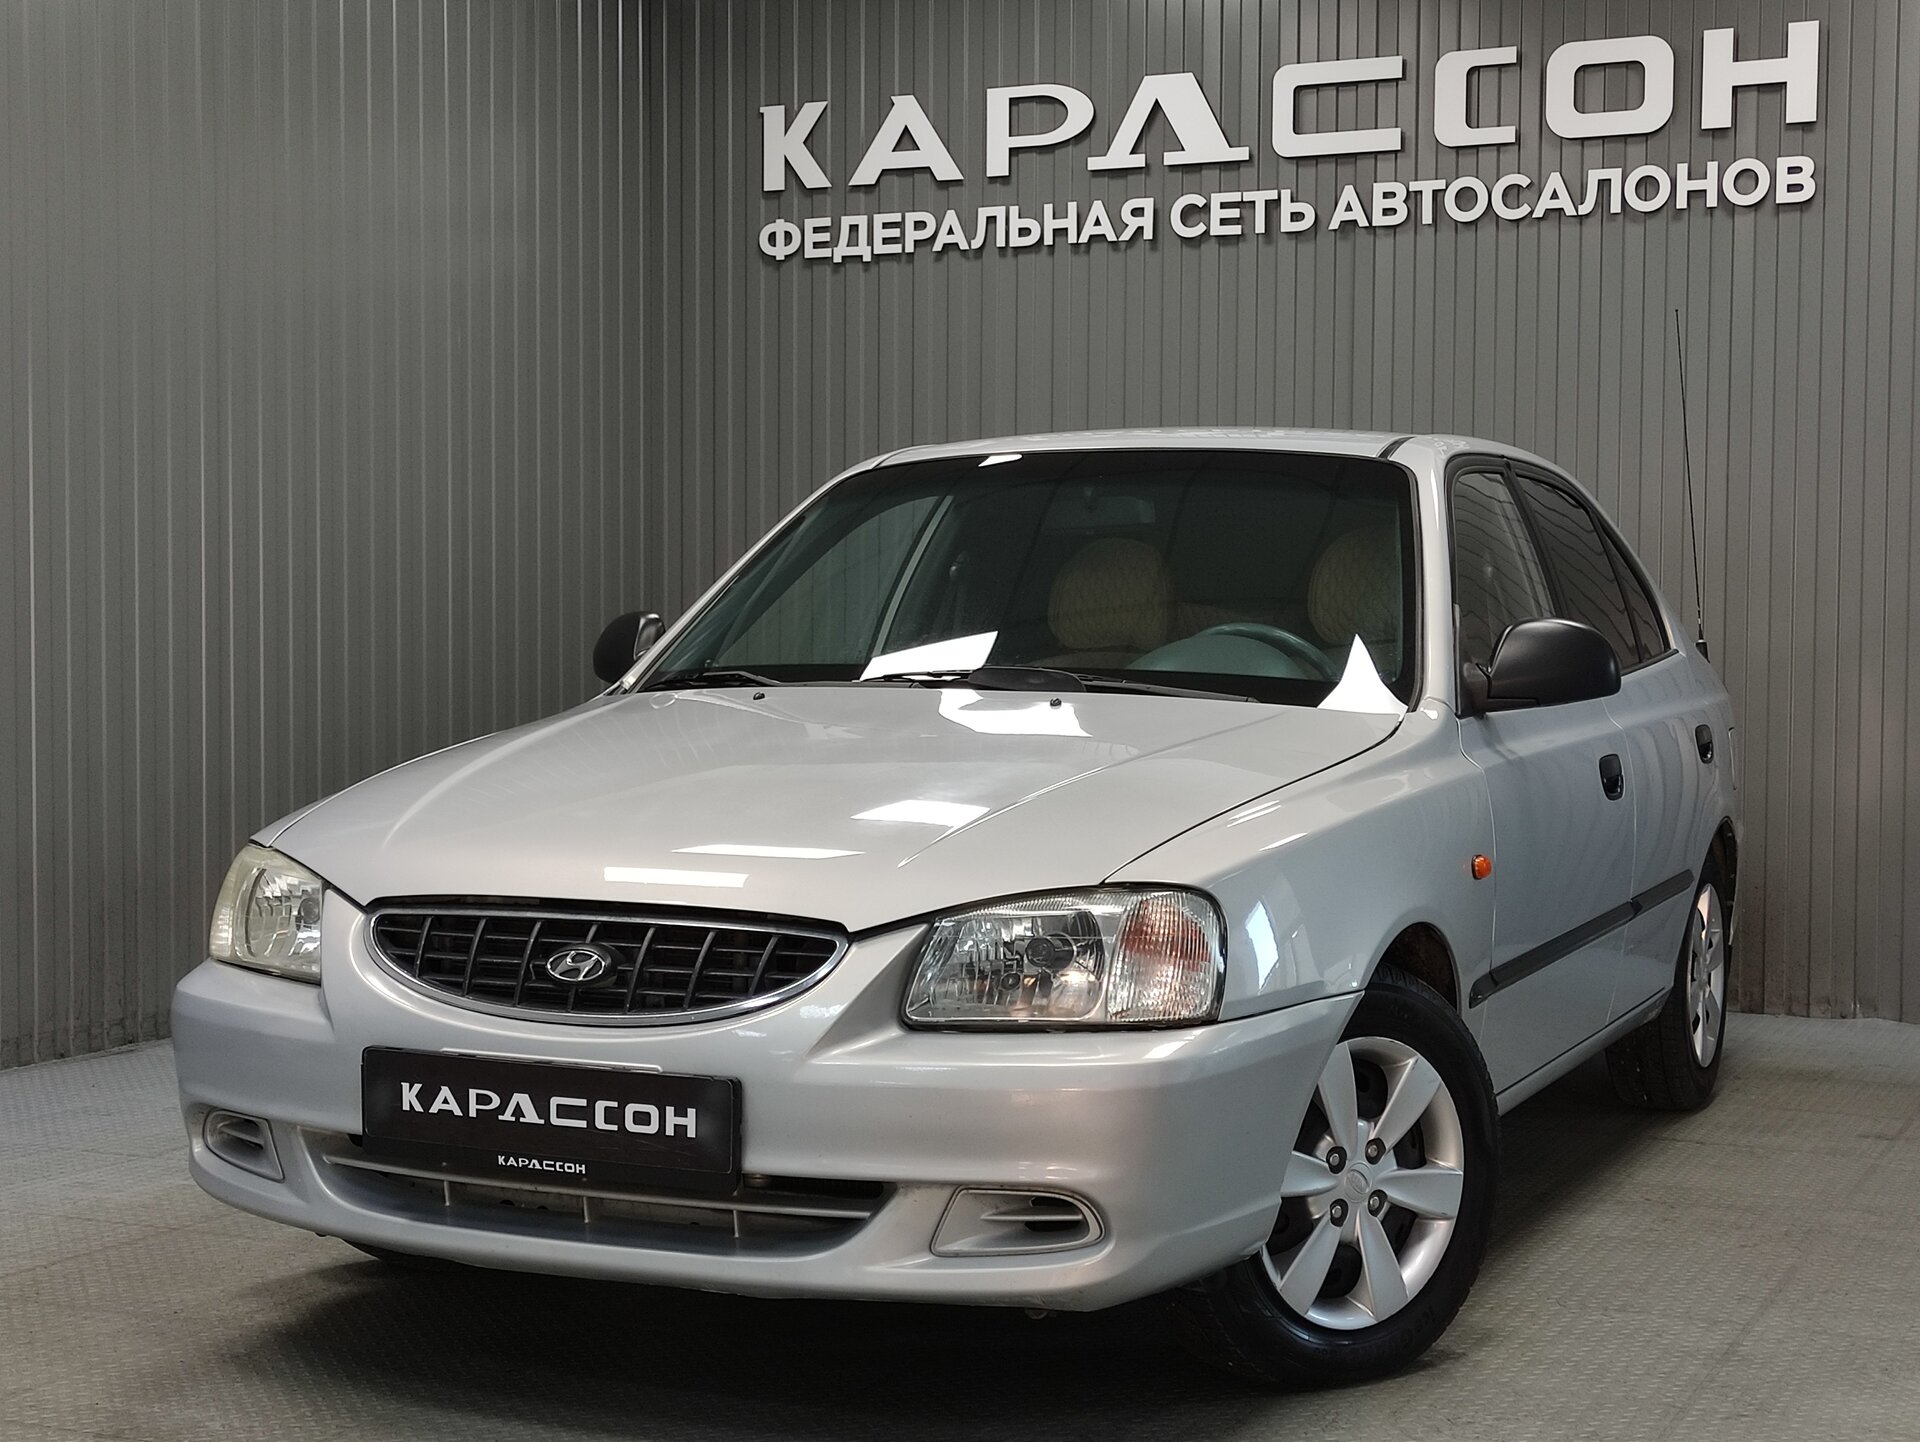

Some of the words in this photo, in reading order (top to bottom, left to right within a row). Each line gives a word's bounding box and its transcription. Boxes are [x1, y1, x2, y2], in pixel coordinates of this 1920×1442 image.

[759, 196, 1154, 263] ФЕДЕРАЛЬНАЯ
[1170, 187, 1316, 240] СЕТЬ
[1328, 155, 1816, 231] АВТОСАЛОНОВ
